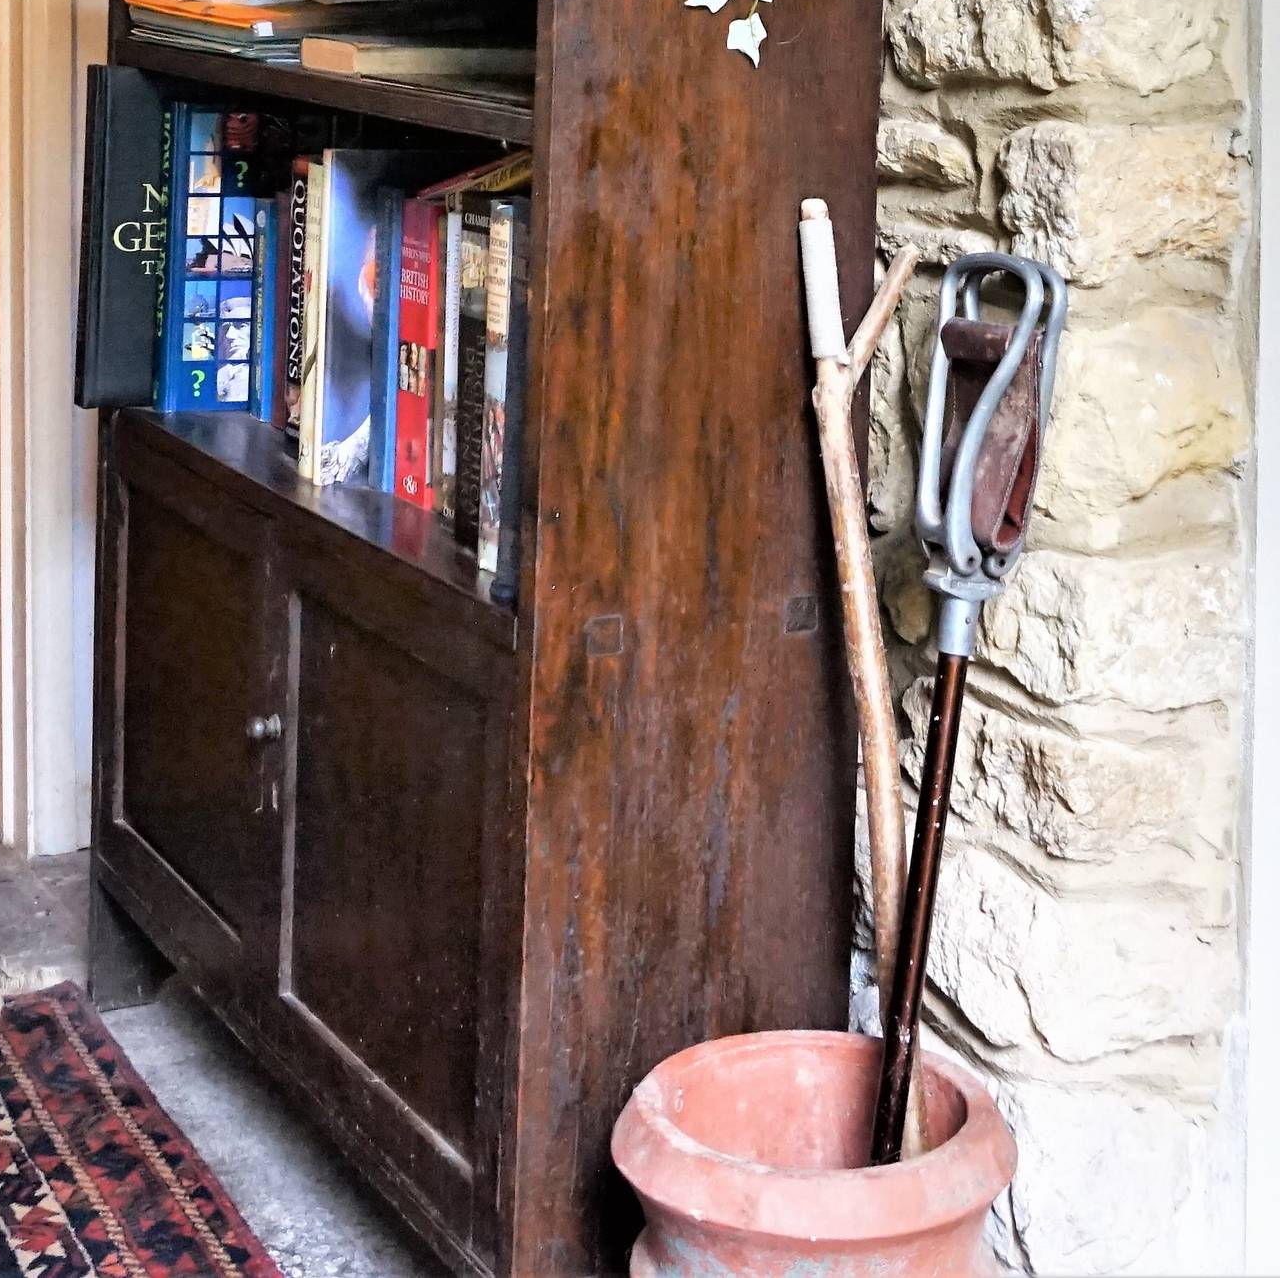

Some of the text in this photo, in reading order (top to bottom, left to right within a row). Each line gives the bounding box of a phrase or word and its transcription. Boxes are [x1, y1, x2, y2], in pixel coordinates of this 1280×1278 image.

[288, 178, 307, 379] QUOTATIONS
[401, 268, 429, 291] BRITISH
[400, 284, 430, 306] HISTORY
